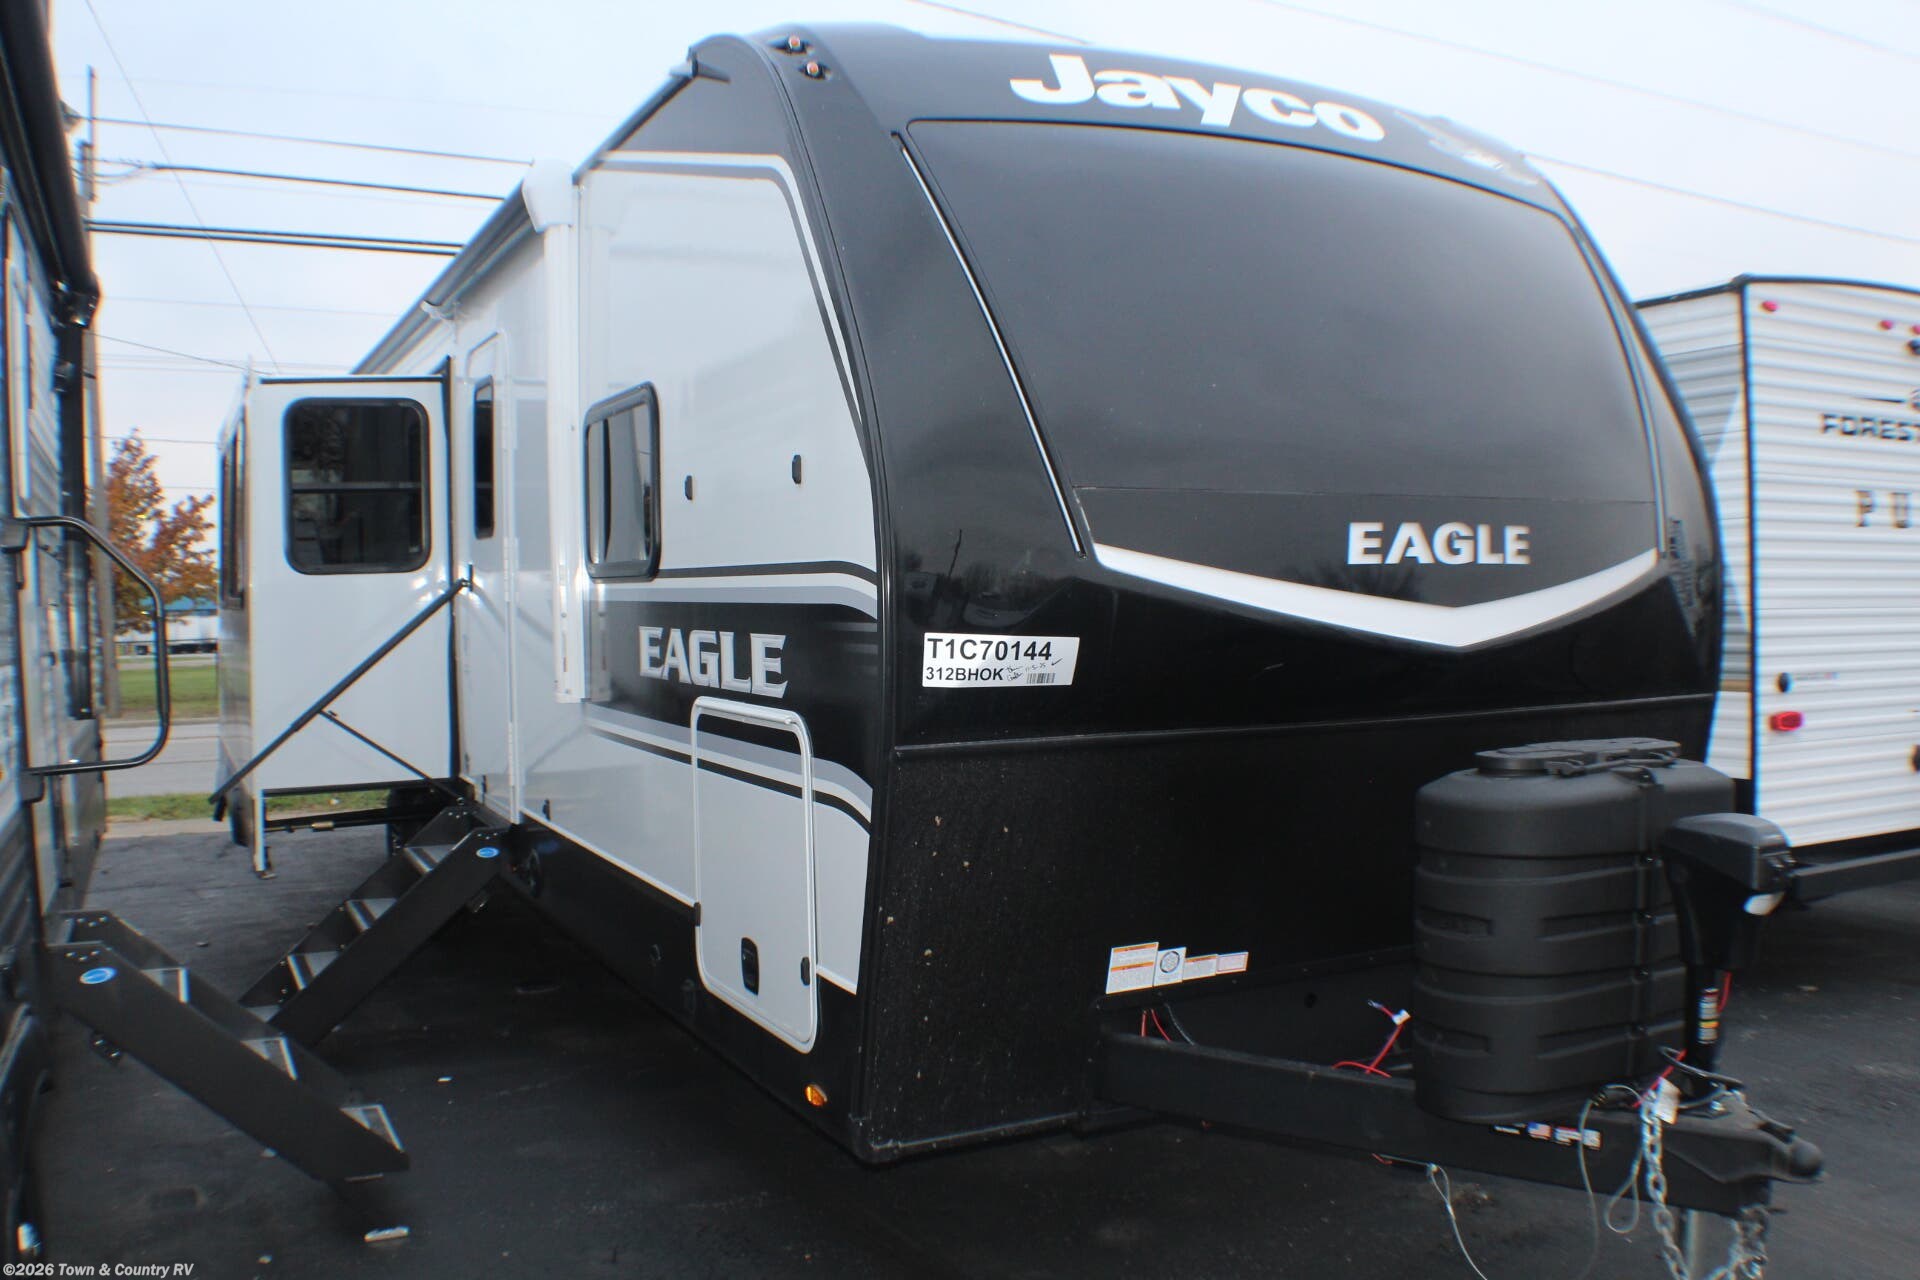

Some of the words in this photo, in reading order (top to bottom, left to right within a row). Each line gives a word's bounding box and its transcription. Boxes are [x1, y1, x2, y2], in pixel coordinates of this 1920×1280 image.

[1009, 54, 1385, 141] Jayco
[1347, 521, 1531, 565] EAGLE
[638, 625, 788, 698] EAGLE
[927, 637, 1052, 661] T1C70144
[926, 666, 1004, 681] 312BHOK
